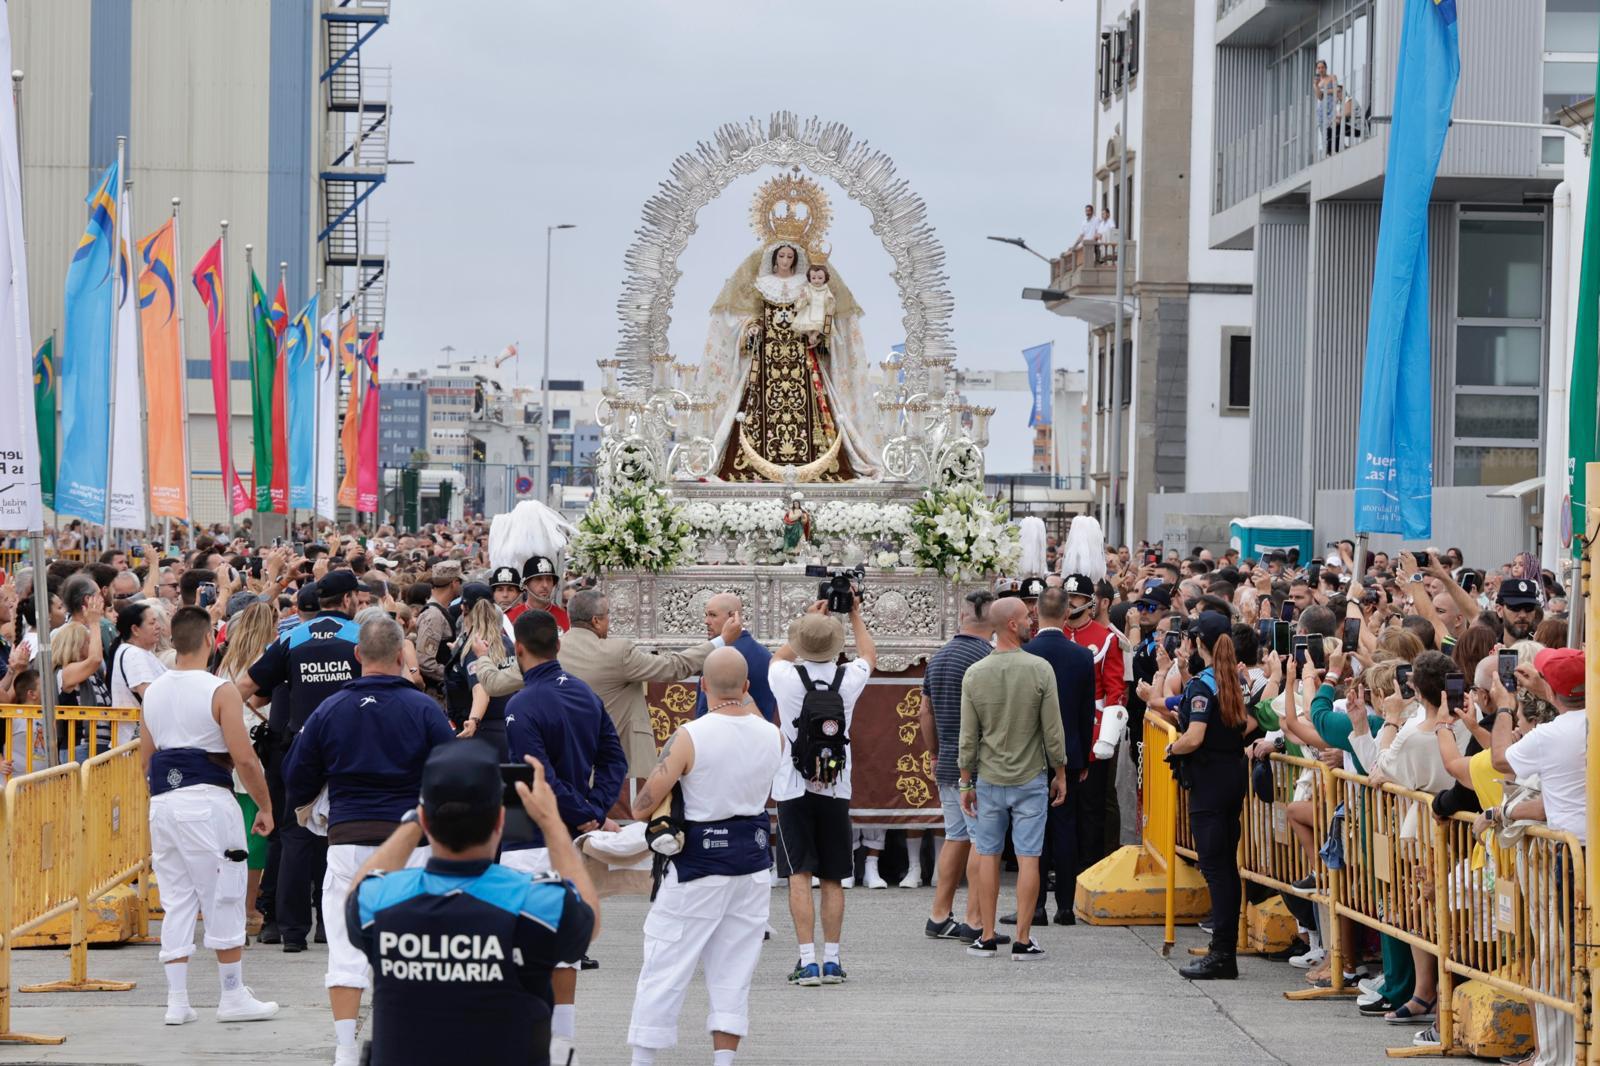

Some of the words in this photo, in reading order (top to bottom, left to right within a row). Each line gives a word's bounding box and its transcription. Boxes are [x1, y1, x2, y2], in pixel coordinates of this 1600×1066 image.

[1365, 470, 1385, 481] as
[300, 660, 352, 674] POLICIA
[301, 672, 353, 683] PORTUARIA
[380, 931, 505, 960] POLICIA
[381, 958, 504, 982] PORTUARIA
